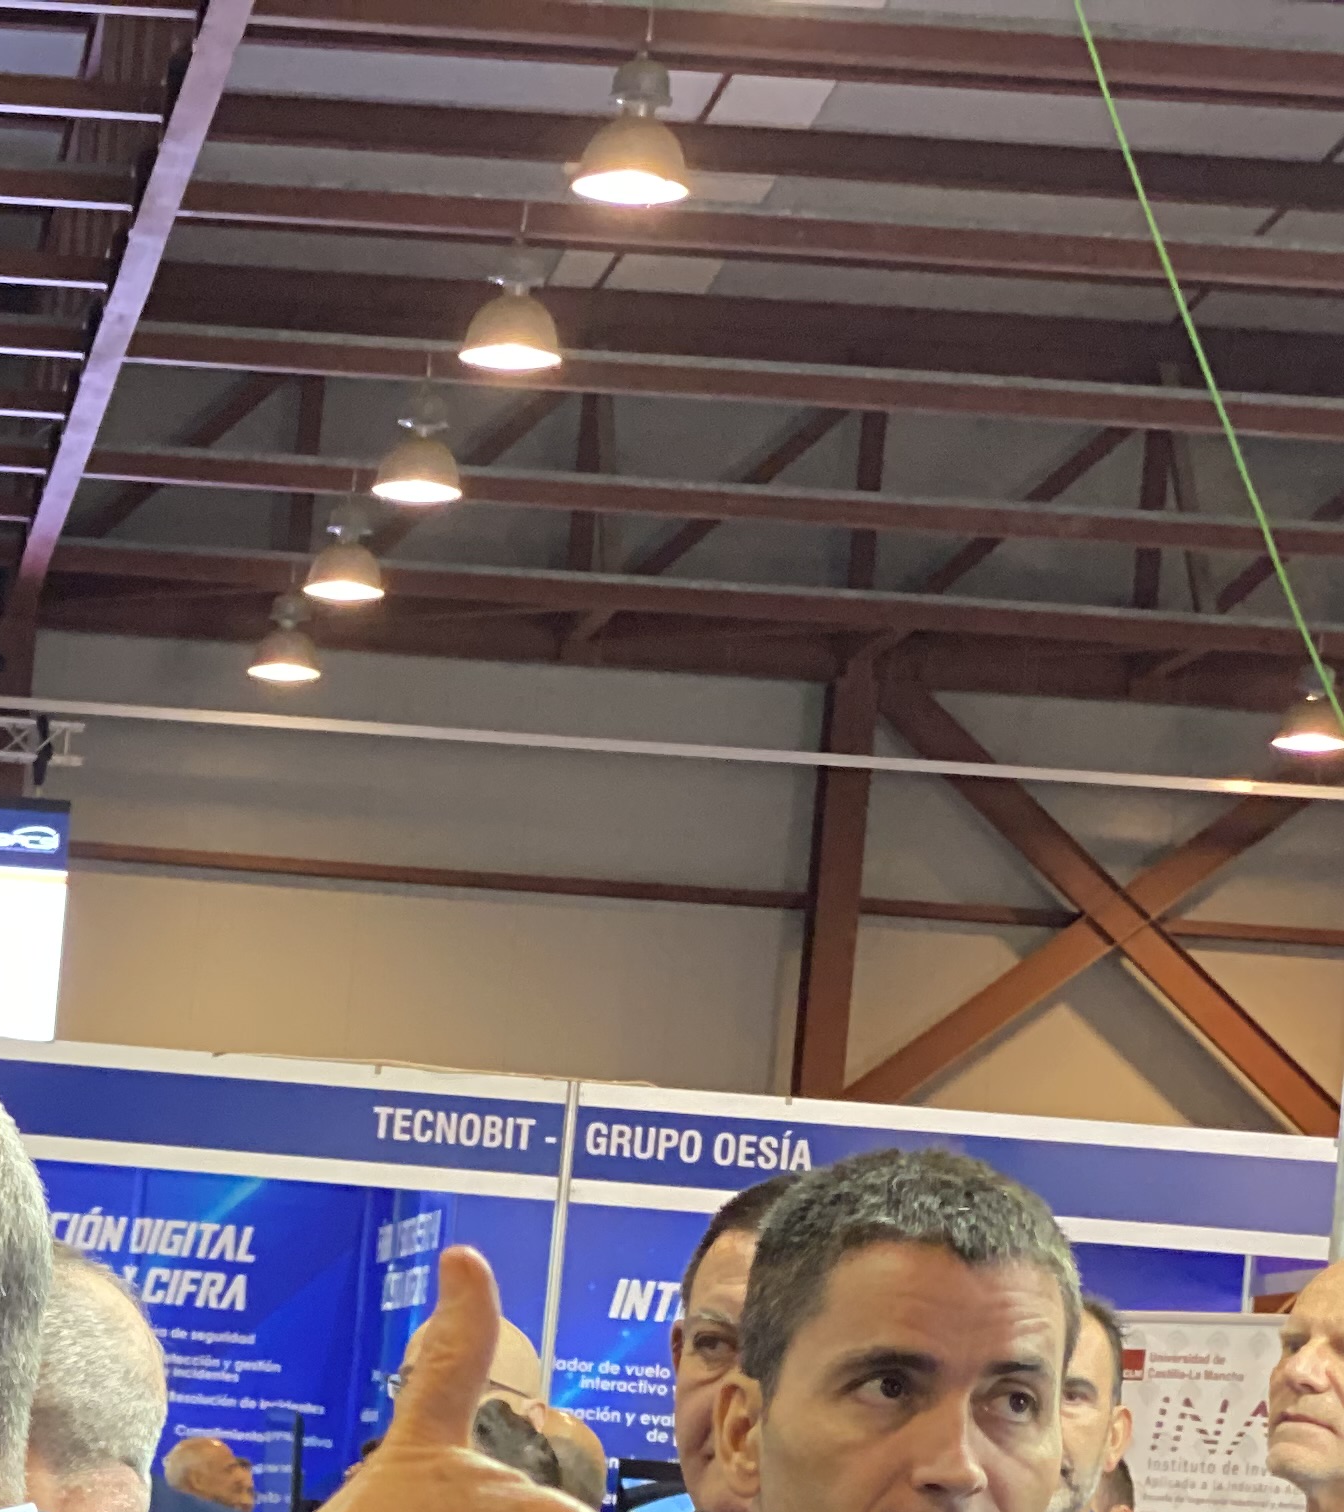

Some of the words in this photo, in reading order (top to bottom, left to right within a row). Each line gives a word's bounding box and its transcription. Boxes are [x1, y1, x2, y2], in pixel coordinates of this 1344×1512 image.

[373, 1106, 537, 1151] TECNOBIT
[585, 1122, 703, 1164] GRUPO
[714, 1131, 812, 1172] OESÍA
[129, 1216, 256, 1263] DIGITAL
[141, 1267, 247, 1311] CIFRA
[608, 1278, 685, 1322] INT
[598, 1359, 621, 1375] de
[625, 1362, 672, 1380] vuelo
[580, 1374, 668, 1397] interactivo
[625, 1411, 636, 1427] y
[646, 1428, 669, 1444] de
[1222, 1459, 1240, 1476] de
